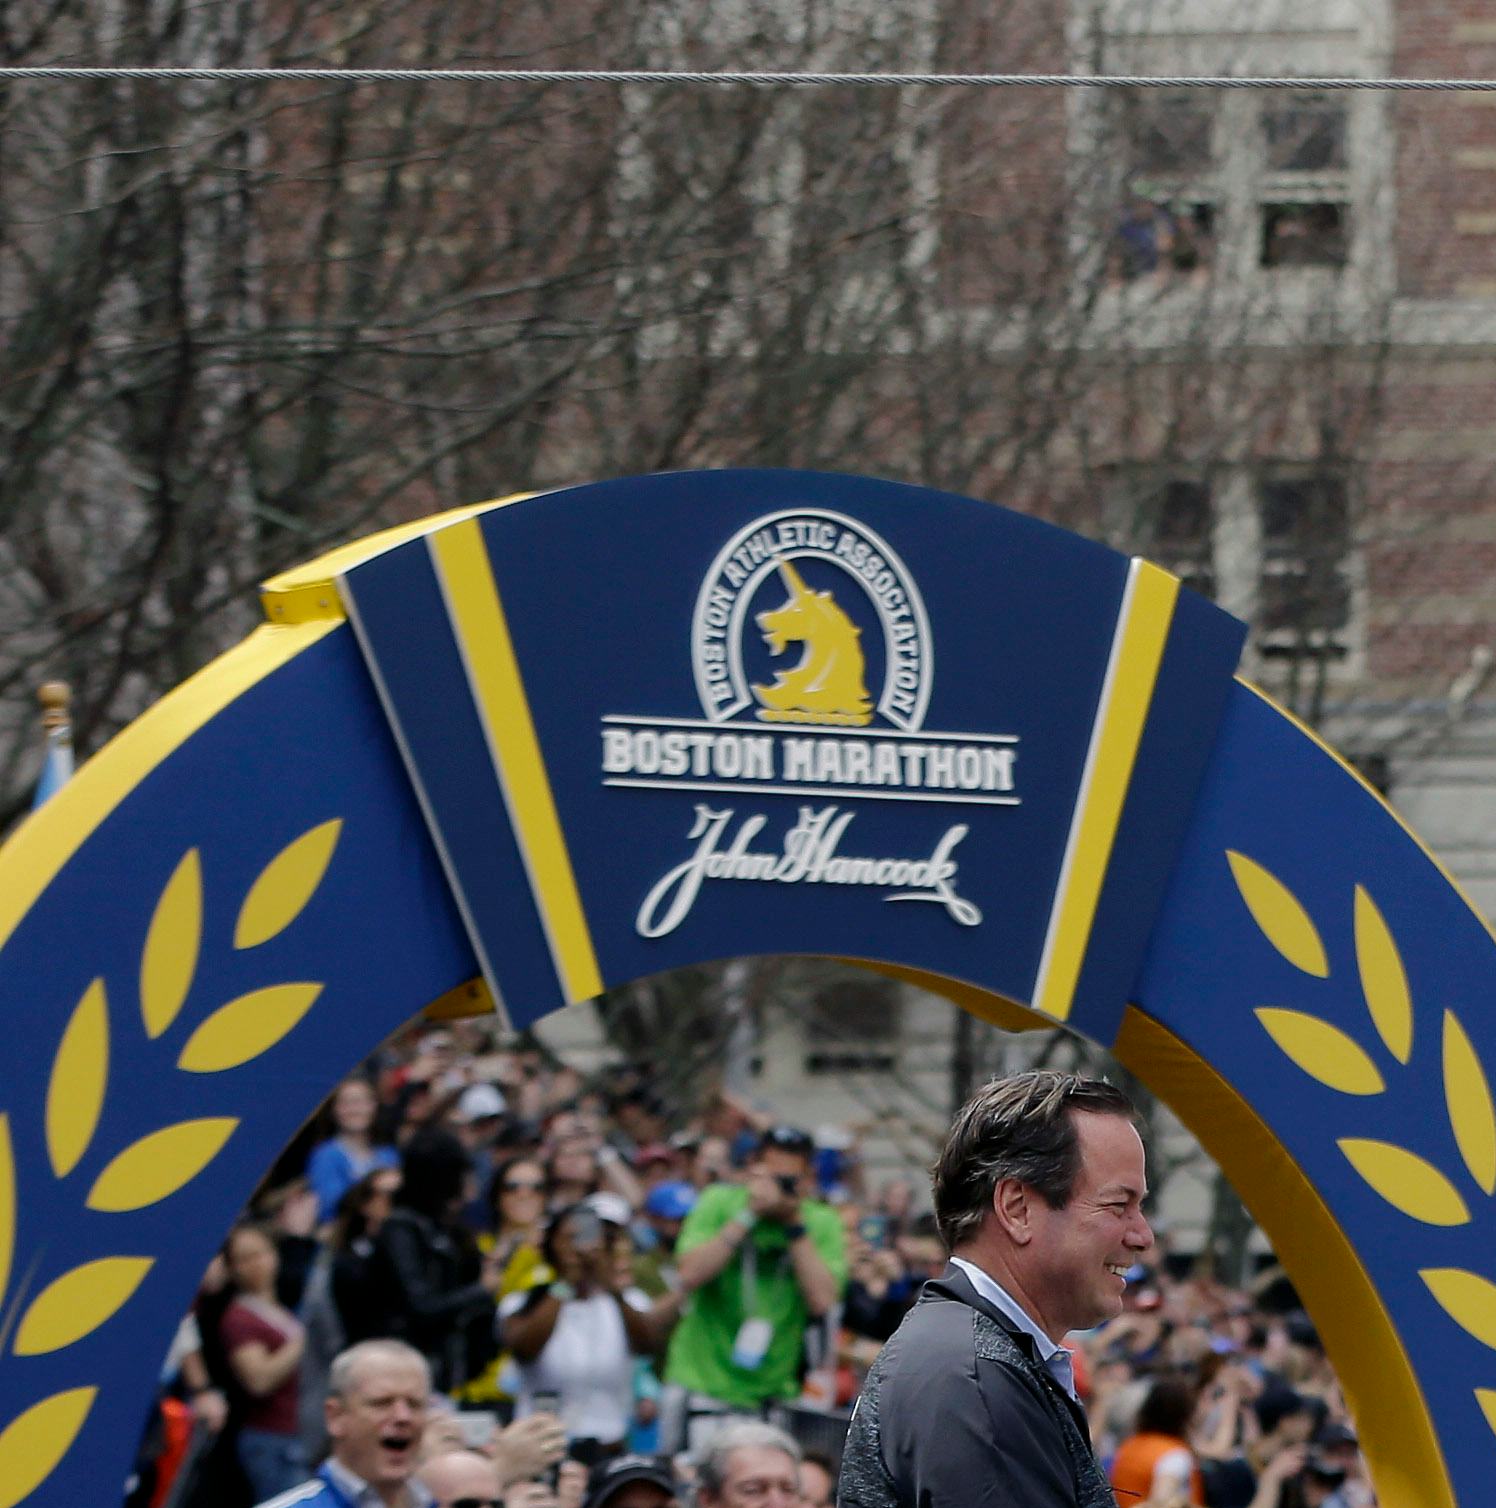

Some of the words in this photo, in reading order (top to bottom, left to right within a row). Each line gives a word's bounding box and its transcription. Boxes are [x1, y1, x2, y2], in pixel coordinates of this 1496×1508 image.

[704, 585, 735, 704] BOSTON
[722, 521, 837, 588] ATHLETIC
[835, 532, 920, 714] ASSOCIATION
[601, 729, 774, 781] BOSTON
[783, 739, 1016, 791] MARATHON
[635, 805, 785, 938] John
[777, 805, 984, 927] Hancock
